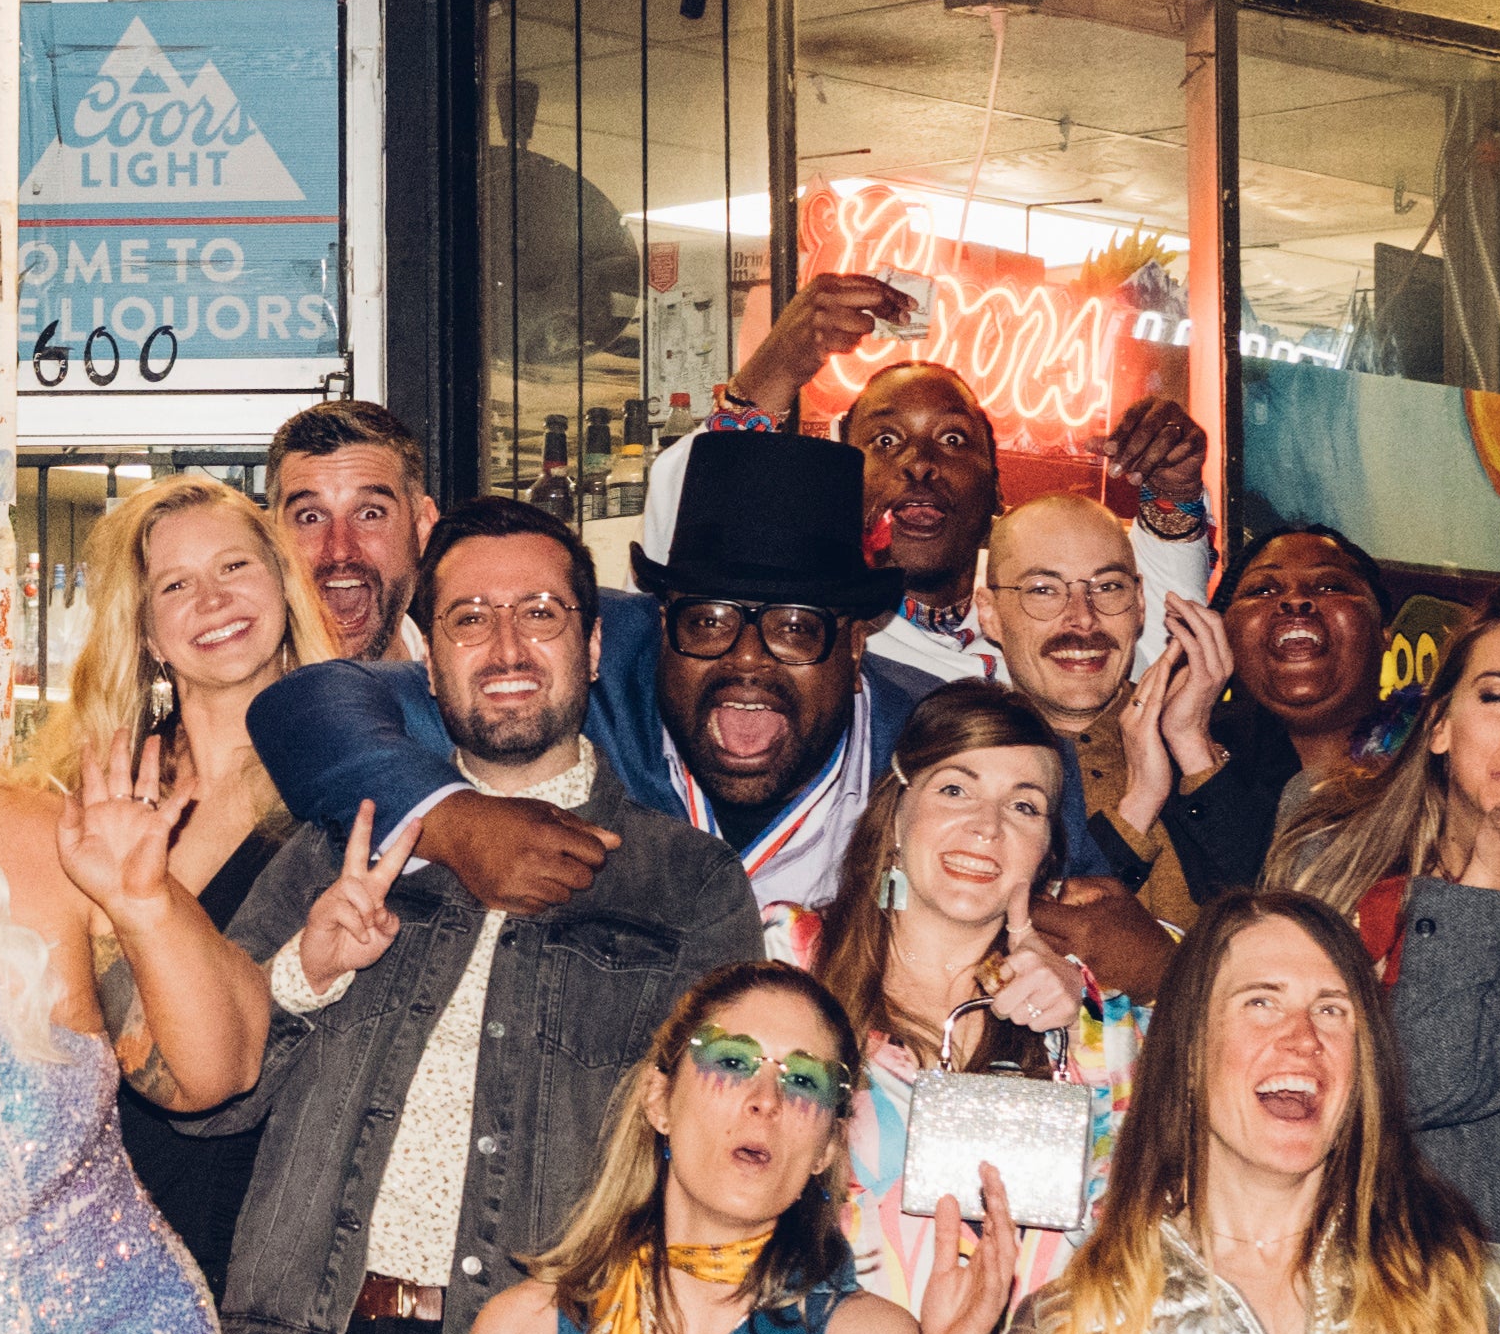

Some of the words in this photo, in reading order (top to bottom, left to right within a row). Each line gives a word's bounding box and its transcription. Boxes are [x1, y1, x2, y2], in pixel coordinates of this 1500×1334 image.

[67, 74, 257, 149] Coors
[81, 151, 231, 188] LIGHT
[167, 237, 245, 285] TO
[61, 294, 329, 357] LIQUORS
